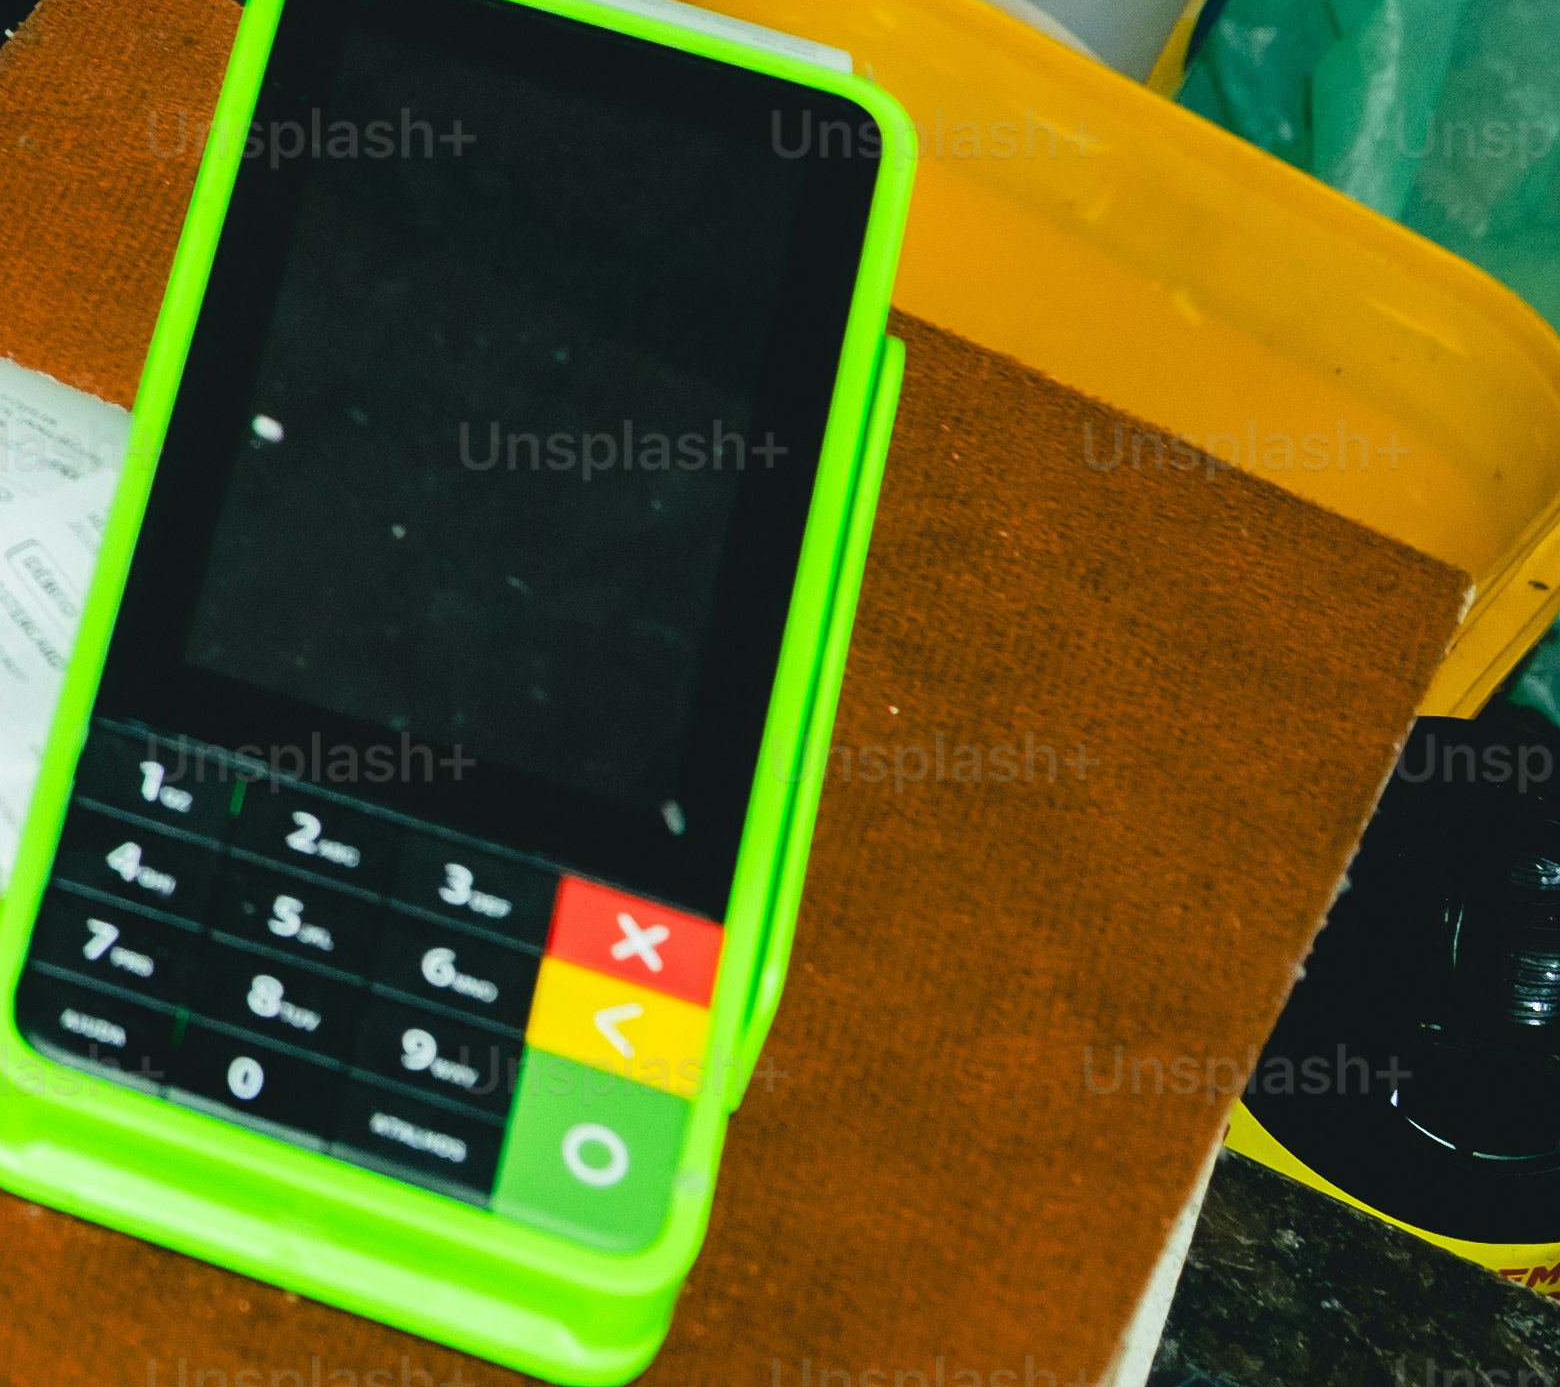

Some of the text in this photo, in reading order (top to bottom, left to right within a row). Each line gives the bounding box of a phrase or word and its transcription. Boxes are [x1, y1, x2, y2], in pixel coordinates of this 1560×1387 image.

[140, 761, 165, 802] 1
[285, 811, 321, 855] 2
[105, 841, 142, 882] 4
[438, 862, 473, 905] 3
[267, 894, 304, 937] 5
[83, 918, 119, 961] 7
[421, 947, 456, 987] 6
[247, 975, 284, 1017] 8
[401, 1028, 437, 1071] 9
[227, 1056, 264, 1100] 0
